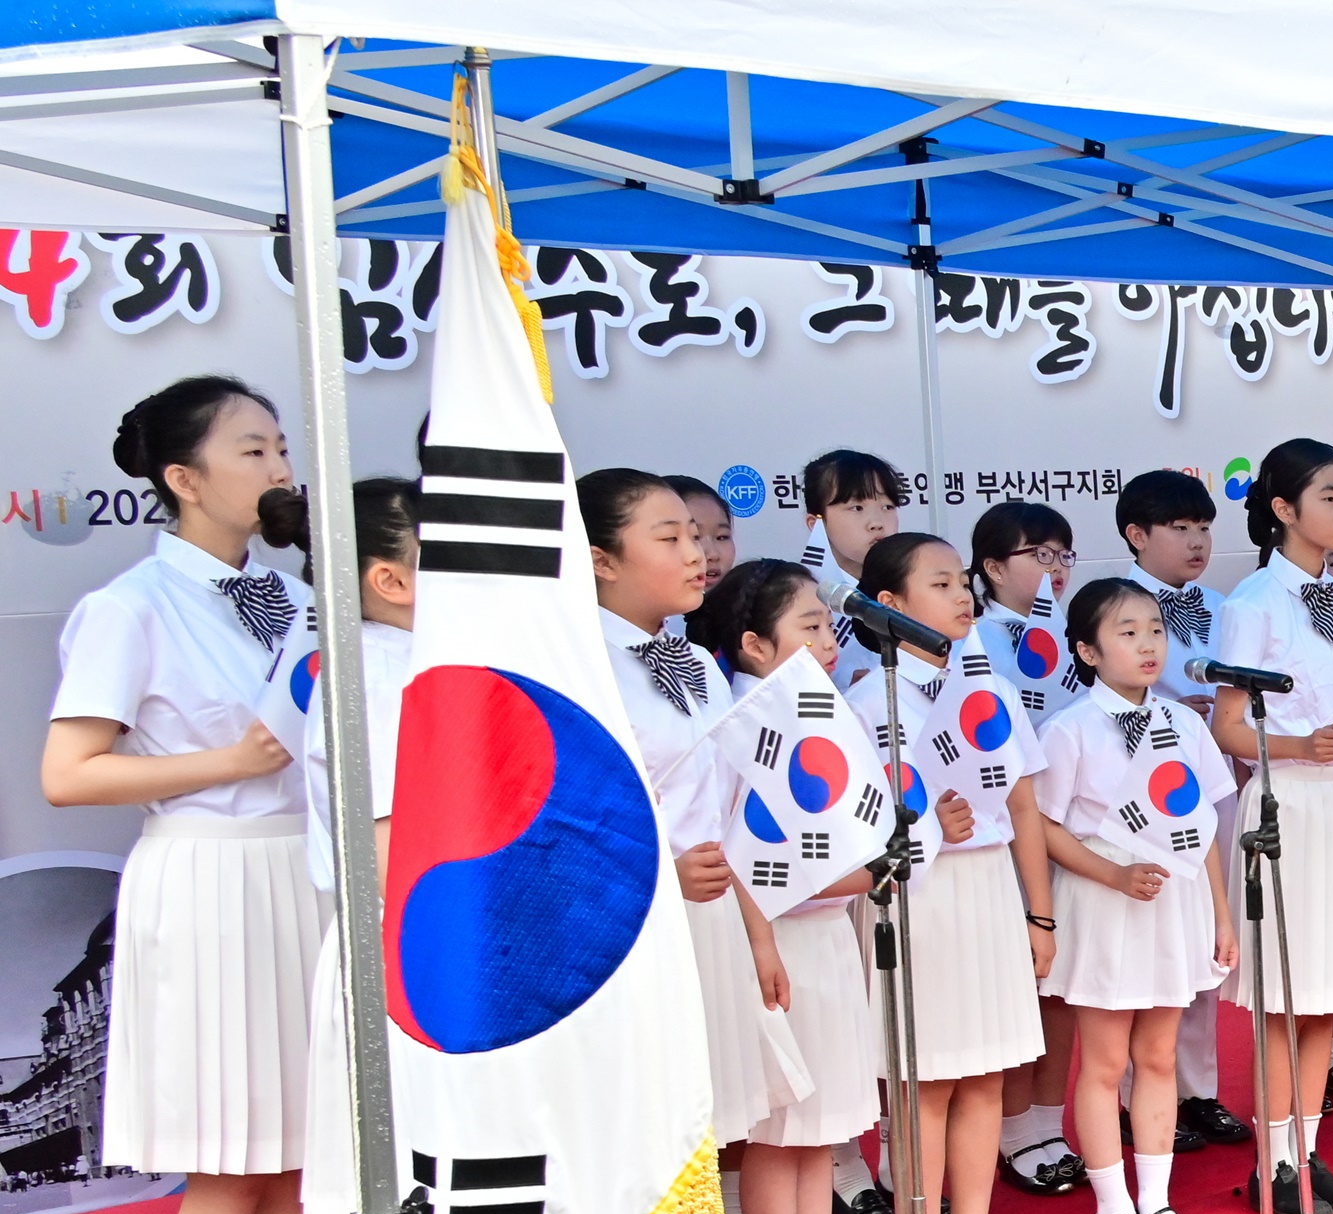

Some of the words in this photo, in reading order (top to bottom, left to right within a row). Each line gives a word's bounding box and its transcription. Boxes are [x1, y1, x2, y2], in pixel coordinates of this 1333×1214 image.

[727, 485, 757, 500] KFF
[975, 468, 1122, 508] 부산서구지회
[86, 489, 172, 526] 202
